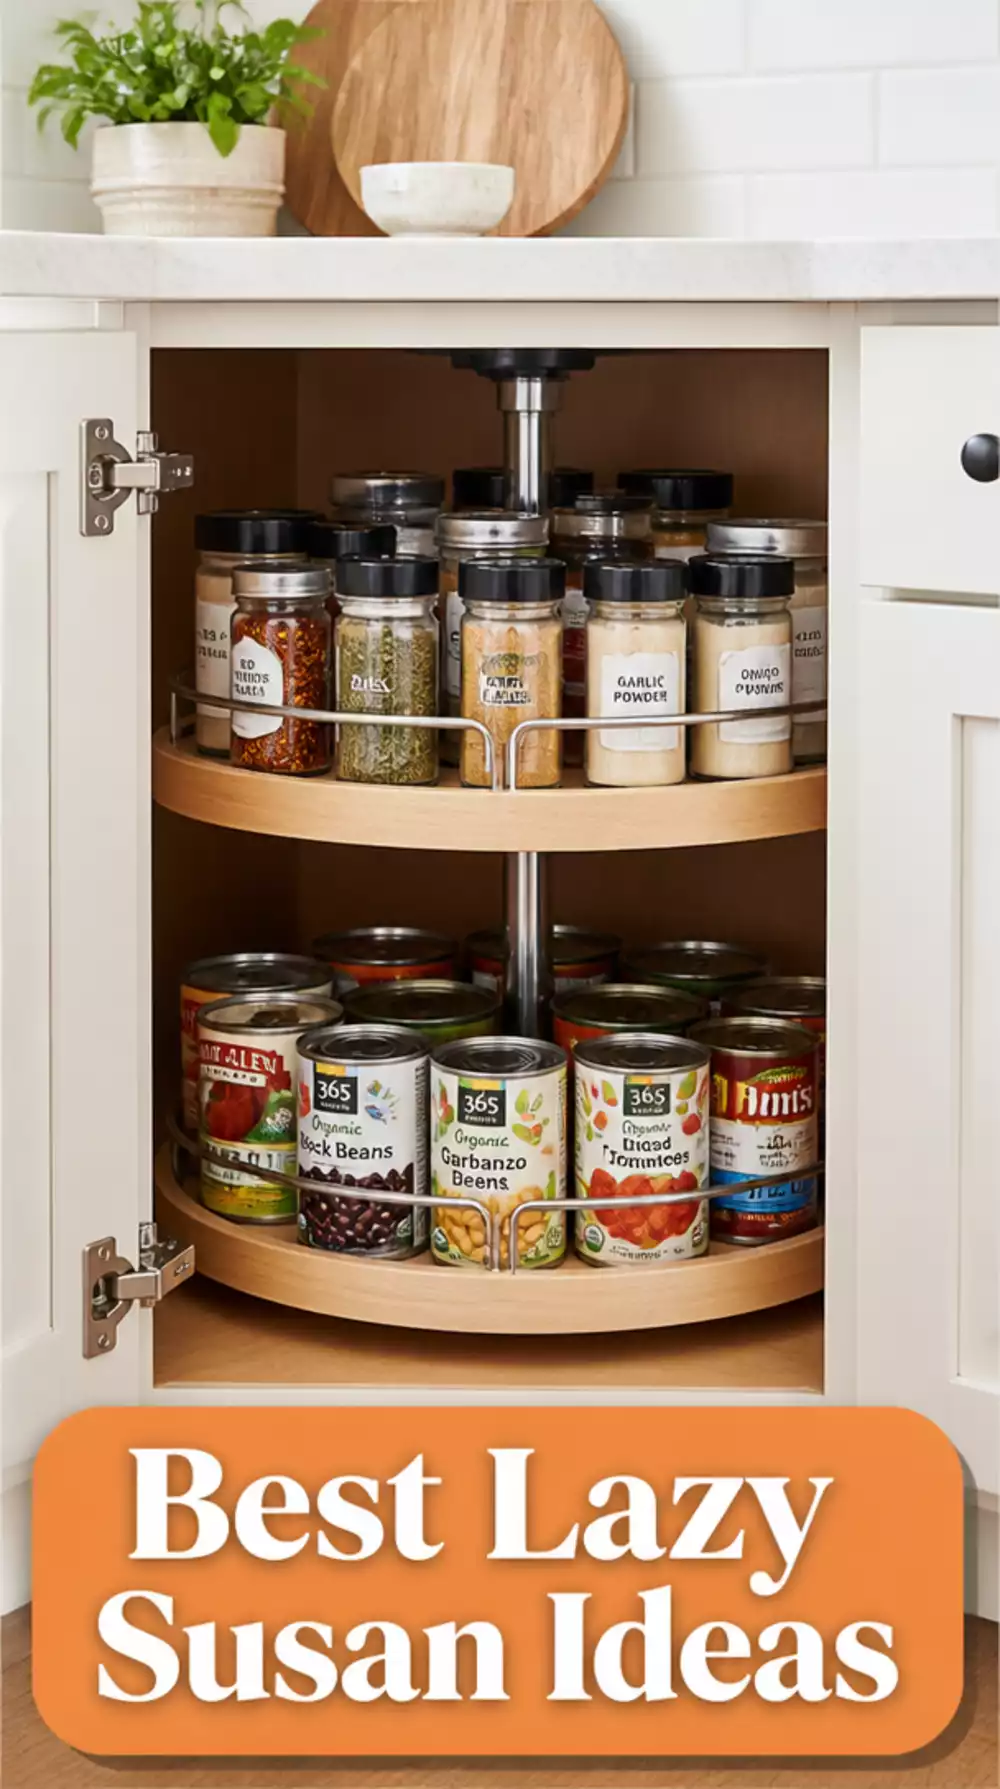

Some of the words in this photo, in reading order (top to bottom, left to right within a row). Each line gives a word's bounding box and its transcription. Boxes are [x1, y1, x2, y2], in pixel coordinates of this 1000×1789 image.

[617, 675, 665, 688] GARLIC
[613, 691, 668, 703] POWDER
[316, 1080, 351, 1102] 365
[630, 1086, 666, 1106] 365
[464, 1092, 499, 1115] 365
[335, 1142, 394, 1160] Beans
[441, 1146, 527, 1171] Garbanzo
